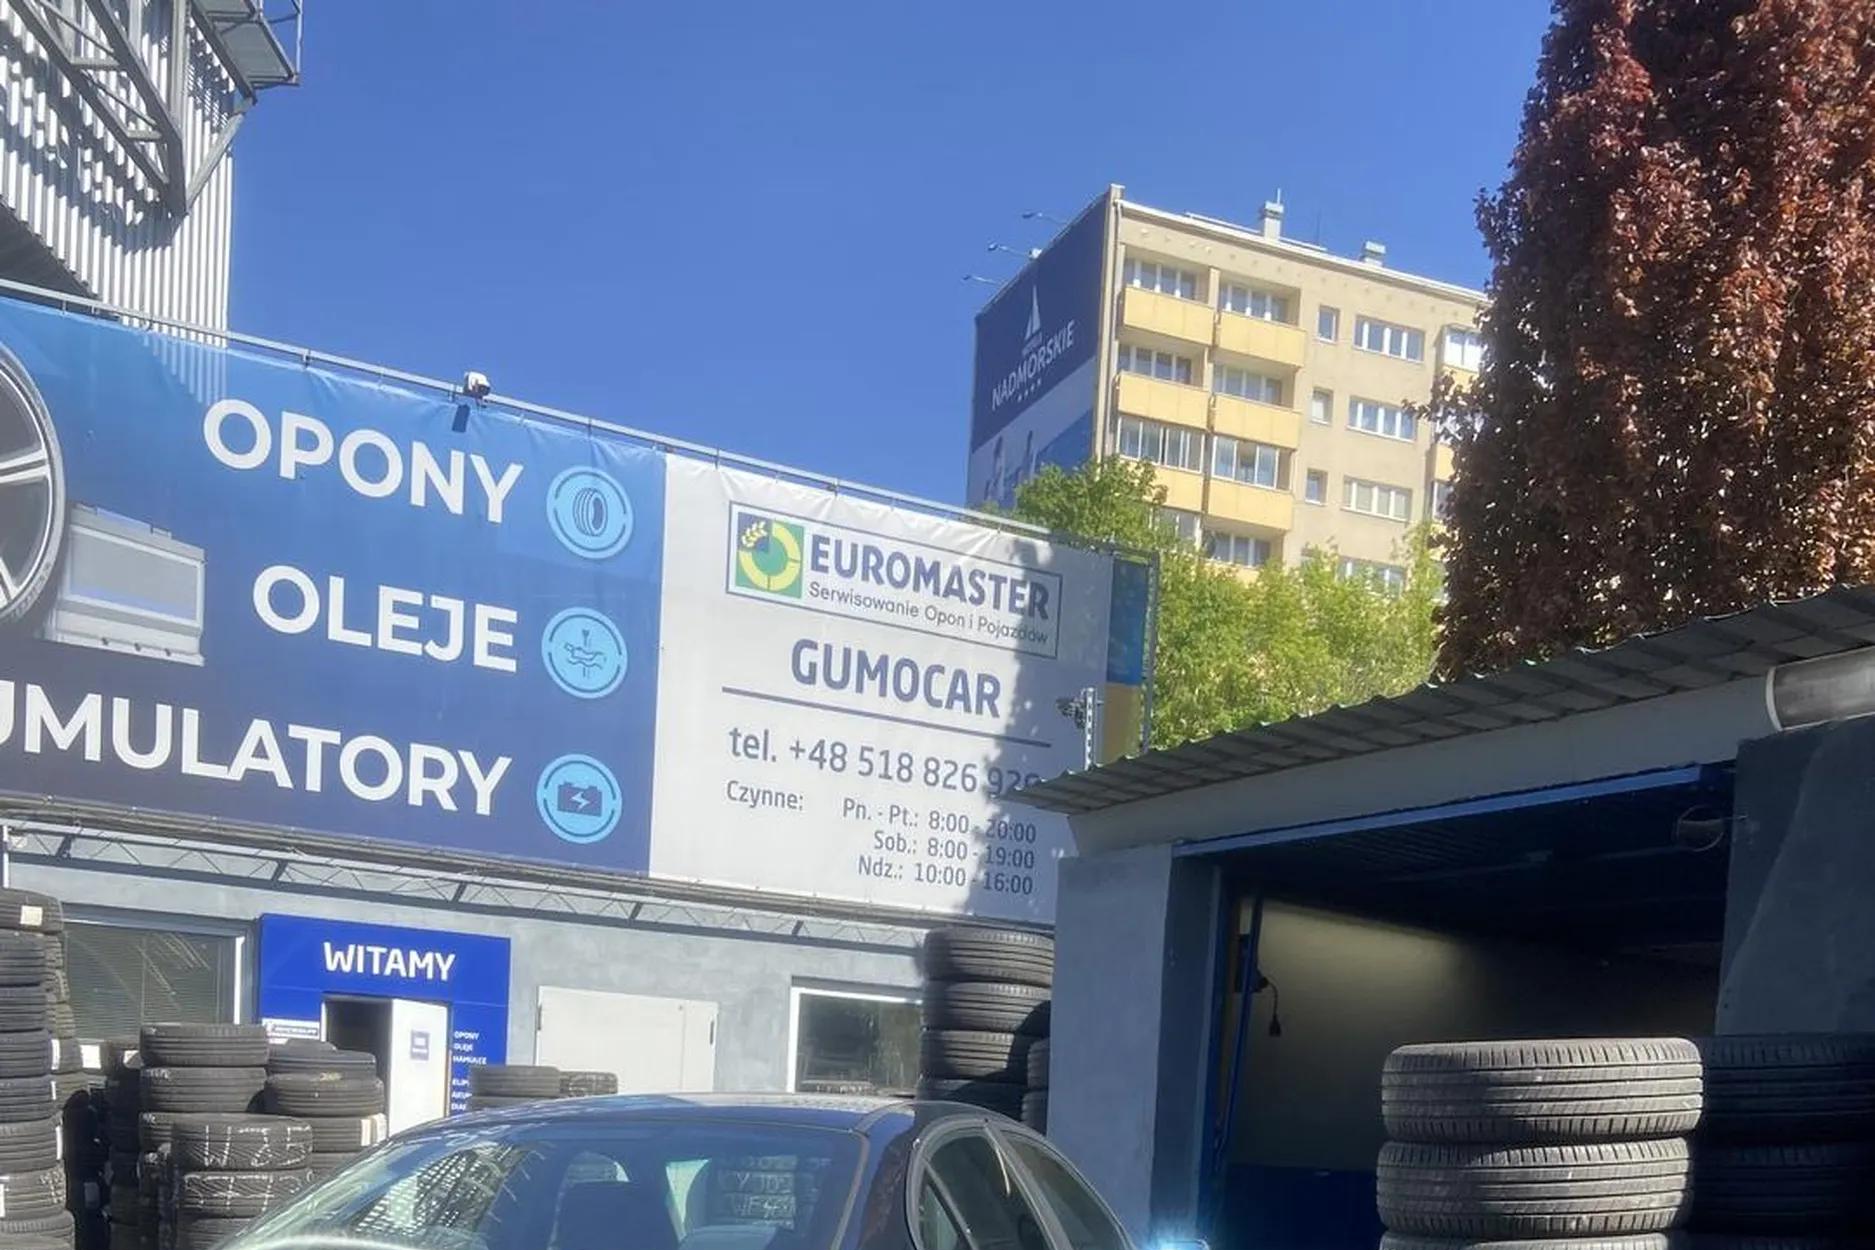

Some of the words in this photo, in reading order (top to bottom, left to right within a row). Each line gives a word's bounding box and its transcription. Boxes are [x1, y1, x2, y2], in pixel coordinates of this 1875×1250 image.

[992, 319, 1075, 411] NADMORSKIE
[204, 399, 524, 524] OPONY
[808, 581, 919, 618] Serwisowanie
[924, 604, 965, 629] Opon
[969, 613, 974, 628] i
[810, 533, 1050, 620] EUROMASTER
[252, 565, 518, 673] OLEJE
[791, 638, 1001, 718] GUMOCAR
[0, 681, 512, 816] MULATORY
[728, 727, 777, 763] tel.
[789, 736, 847, 773] +48
[857, 745, 914, 784] 518
[923, 756, 978, 793] 826
[726, 780, 804, 811] Czynne:
[842, 798, 872, 821] Pn.
[928, 810, 970, 834] 8:00
[985, 819, 1037, 843] 20:00
[858, 854, 903, 879] Ndz.:
[914, 862, 967, 887] 10:00
[982, 872, 1034, 896] 16:00
[873, 830, 917, 854] Sob.:
[927, 837, 968, 861] 8:00
[985, 845, 1035, 869] 19:00
[323, 941, 456, 981] WITAMY
[453, 1030, 480, 1040] OPONY
